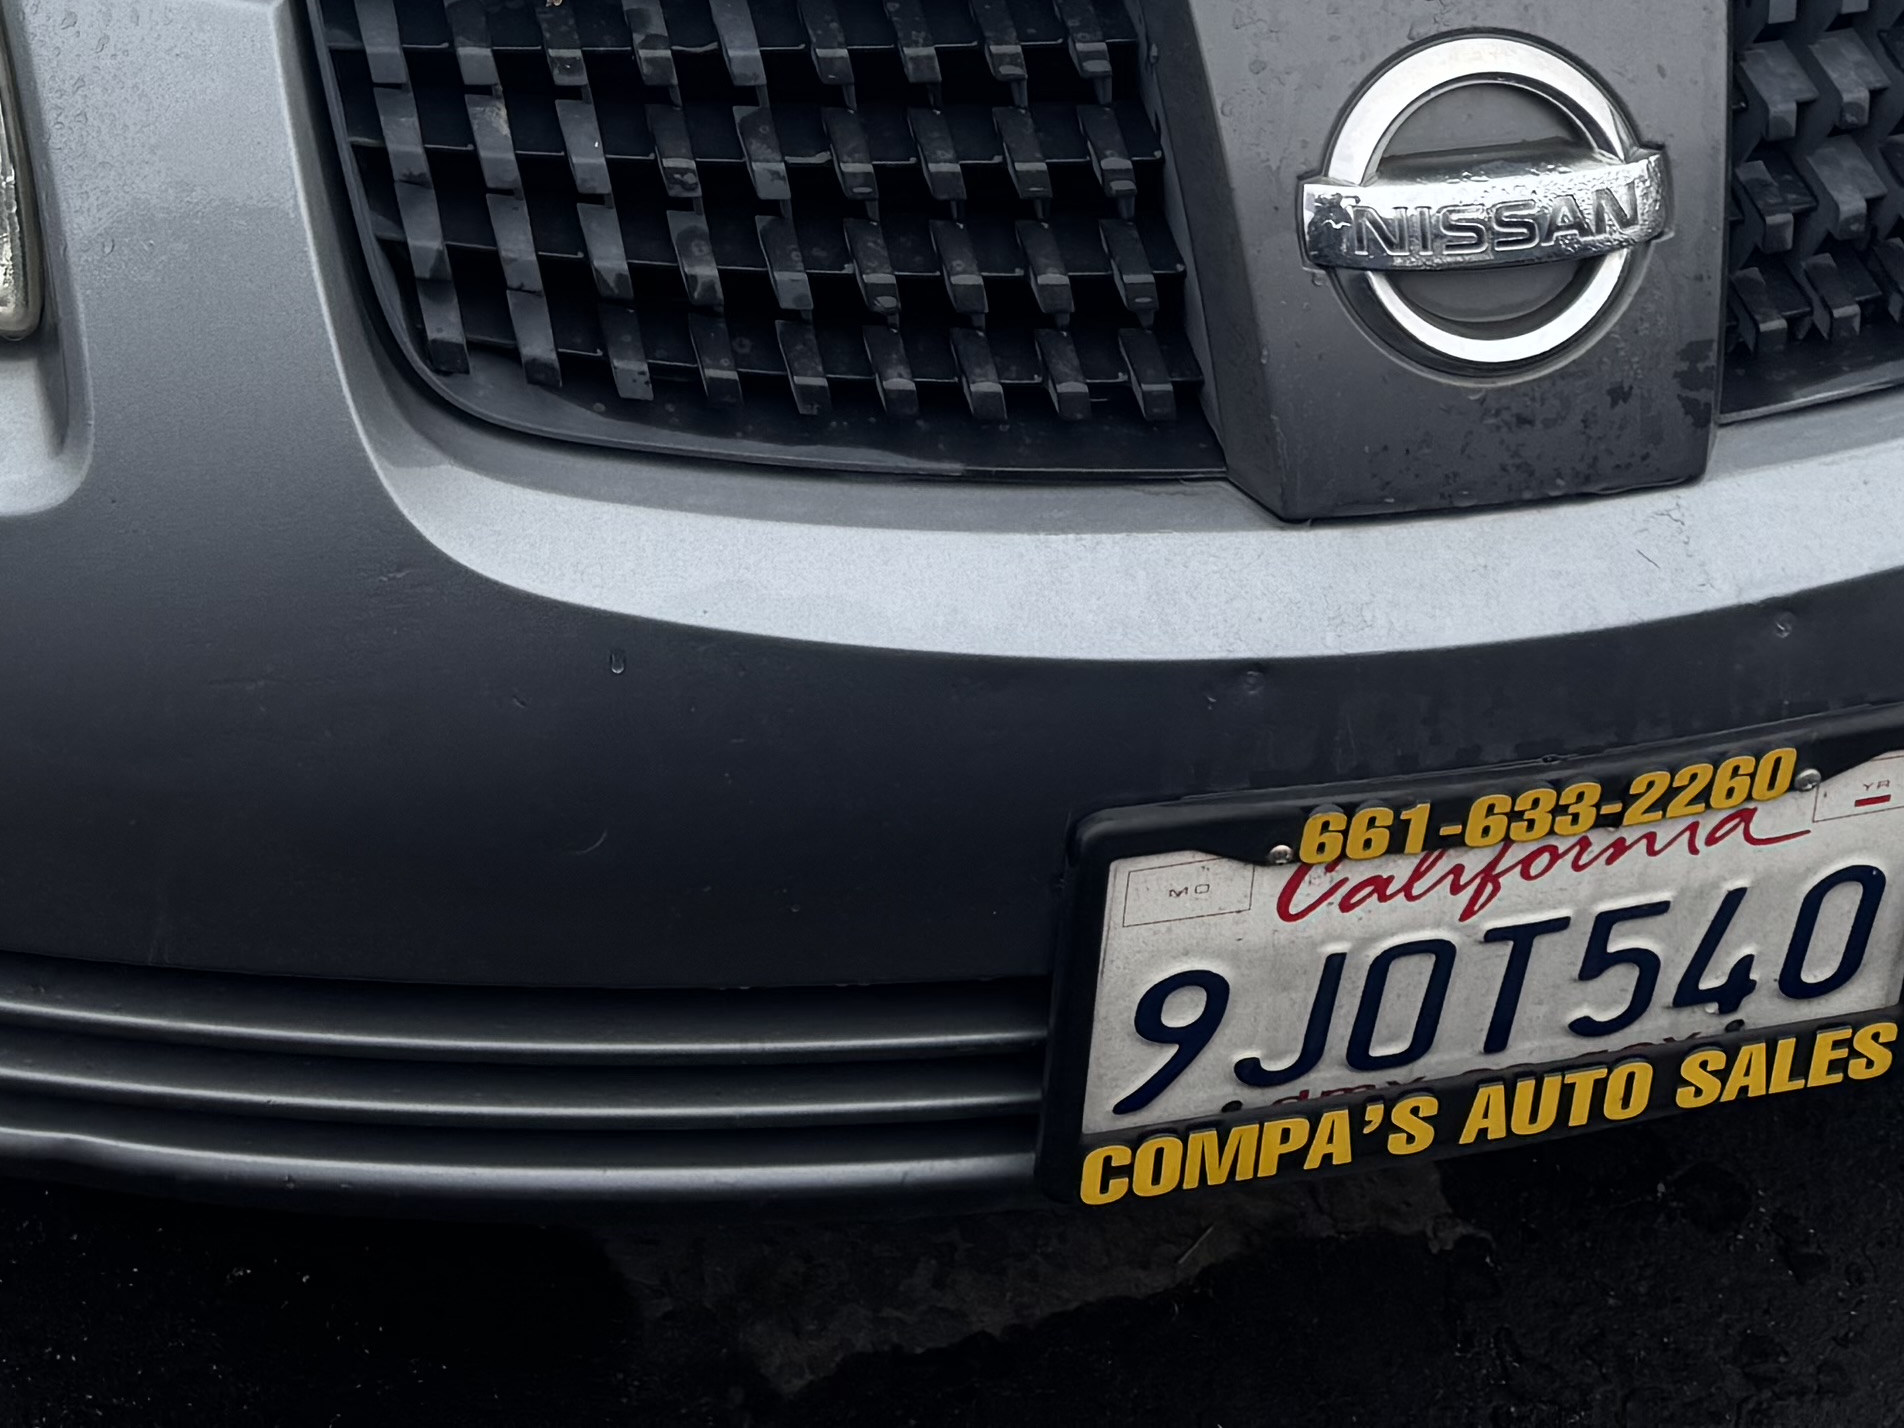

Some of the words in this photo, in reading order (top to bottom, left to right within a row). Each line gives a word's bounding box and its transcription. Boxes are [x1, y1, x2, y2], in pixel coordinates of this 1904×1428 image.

[1347, 178, 1642, 257] NISSAN
[1300, 746, 1798, 864] 661-633-2260
[1111, 862, 1889, 1117] 9JOT540
[1457, 1059, 1655, 1146] AUTO
[1672, 1020, 1899, 1110] SALES
